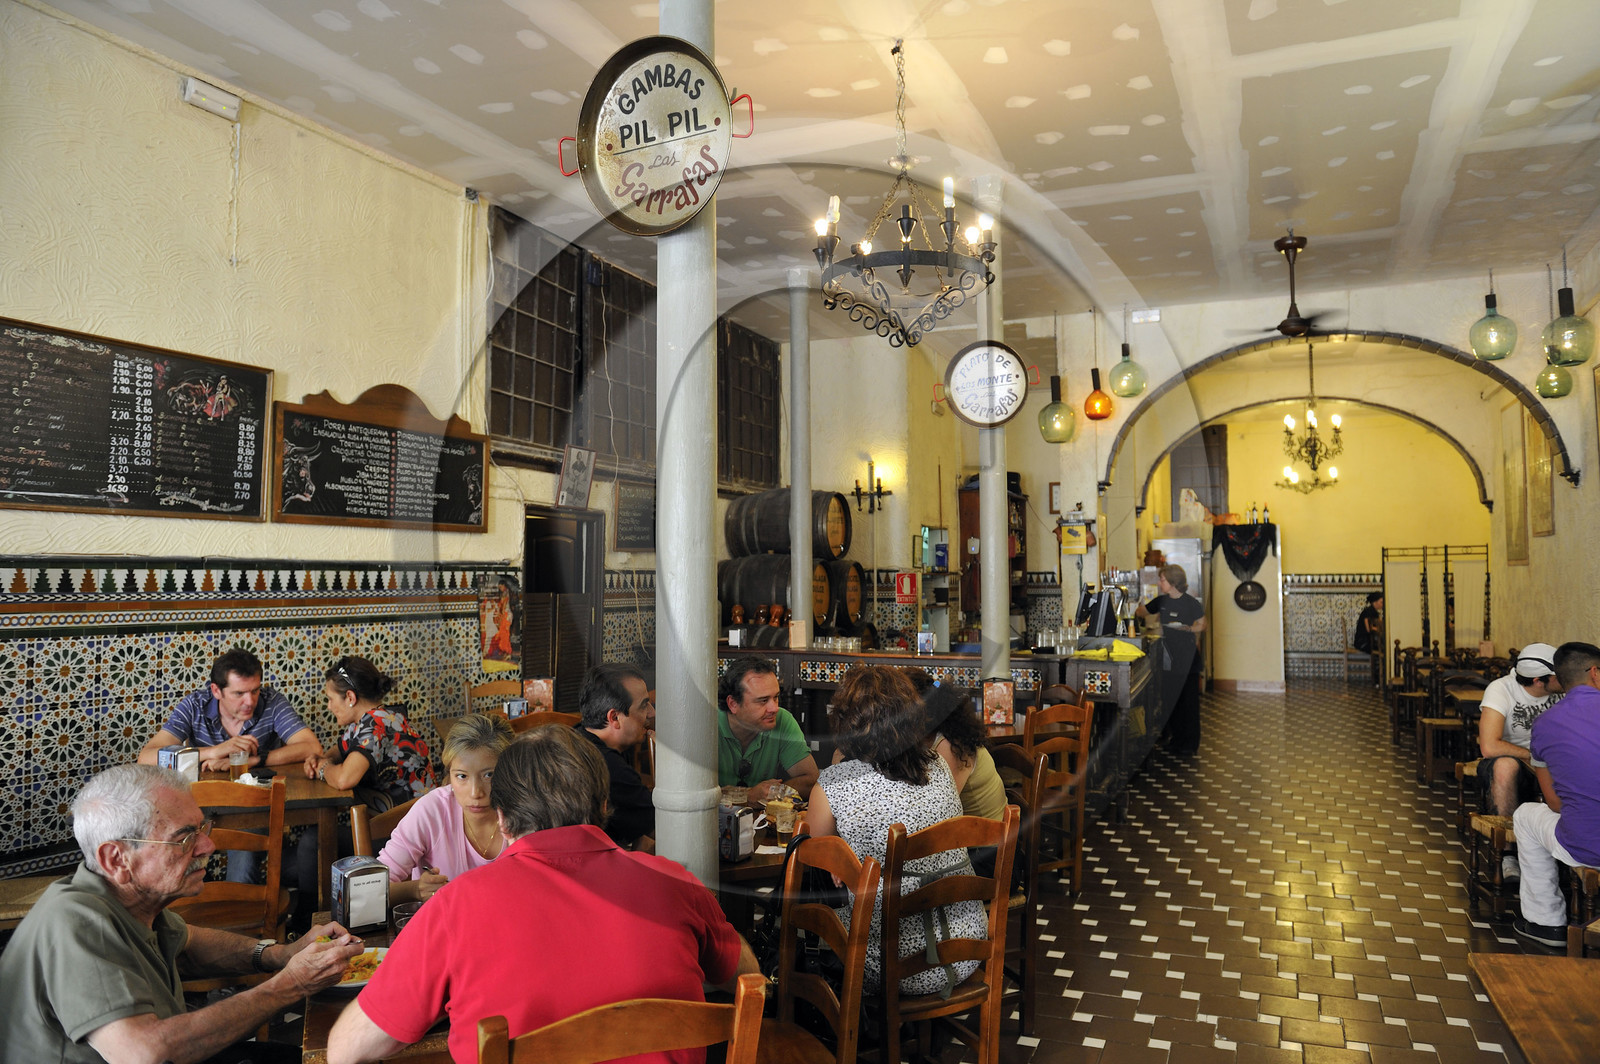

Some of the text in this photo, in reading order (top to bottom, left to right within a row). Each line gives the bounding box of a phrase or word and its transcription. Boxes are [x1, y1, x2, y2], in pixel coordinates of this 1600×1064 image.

[618, 64, 704, 114] GAMBAS
[619, 108, 706, 148] PIL PIL
[648, 151, 680, 169] Las
[615, 145, 719, 214] Garrafas
[960, 352, 1011, 378] PLATO DE
[961, 388, 1018, 418] Garrafas
[313, 427, 345, 439] ENSALADILLA
[324, 419, 388, 437] PORRA ANTEQUERANA
[331, 445, 389, 459] CROQUETAS CASERAS
[340, 440, 364, 449] TORTILLA
[397, 439, 426, 450] ENSALADILLA
[342, 455, 367, 464] PINCHITO
